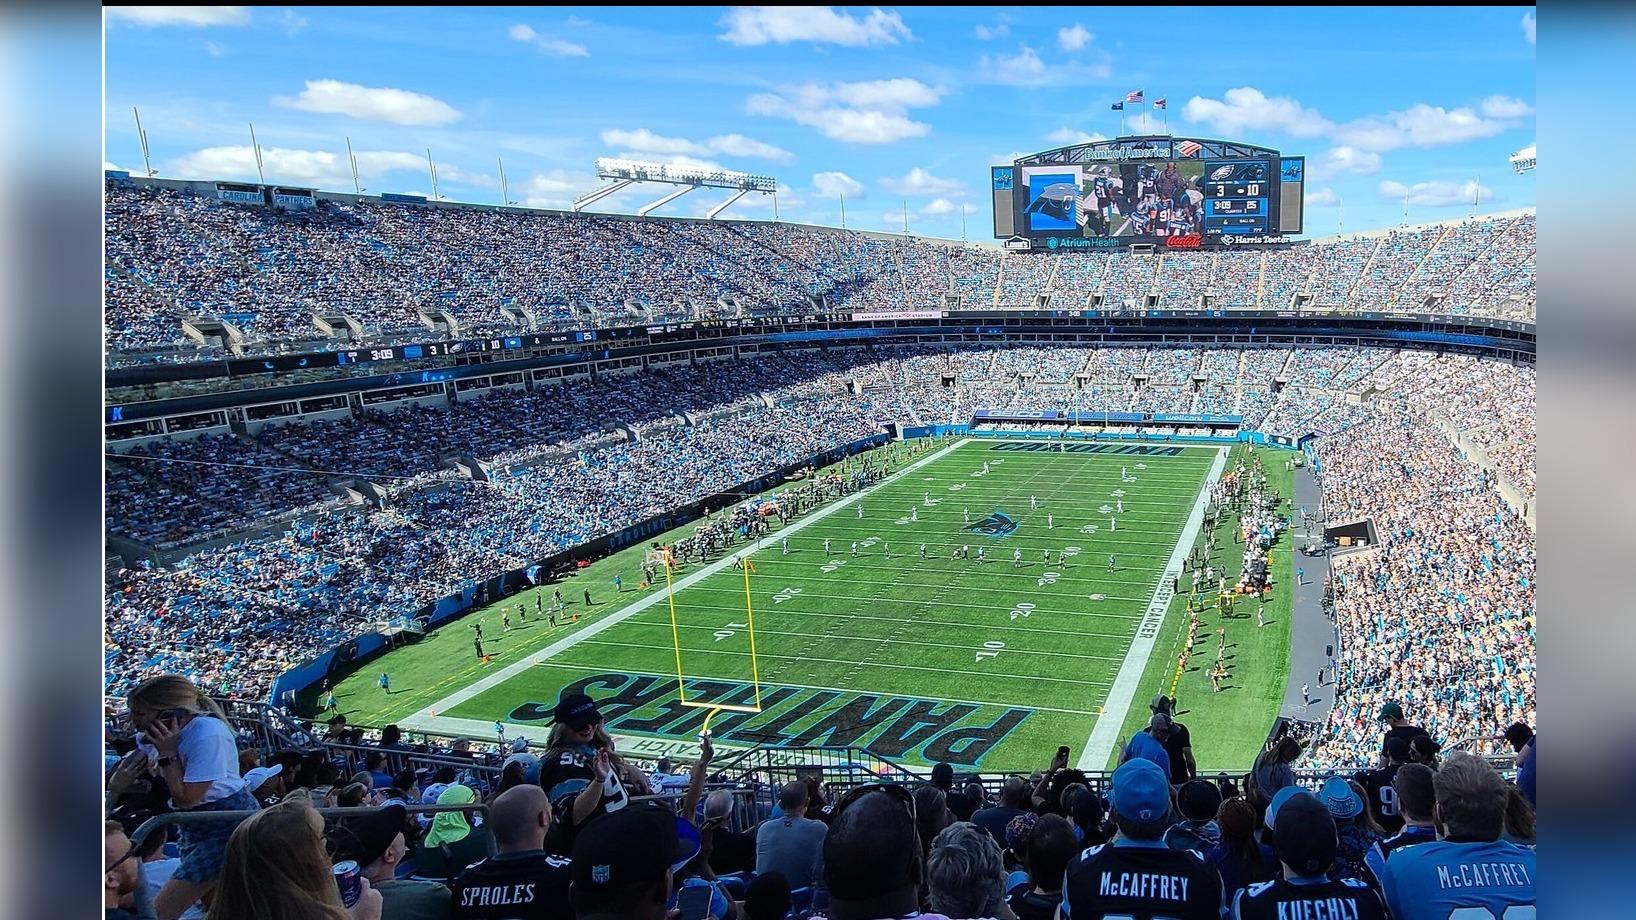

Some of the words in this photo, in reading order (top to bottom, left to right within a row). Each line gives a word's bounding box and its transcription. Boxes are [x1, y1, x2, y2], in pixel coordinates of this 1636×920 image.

[1084, 147, 1109, 159] Bank
[1109, 147, 1124, 160] of
[1125, 146, 1171, 159] America
[222, 190, 264, 203] CAROLINA
[275, 195, 313, 205] PANTHERS
[1217, 185, 1225, 197] 3
[1247, 184, 1259, 196] 10
[1214, 200, 1232, 210] 3:09
[1246, 200, 1257, 209] 25
[1160, 210, 1171, 222] 91
[1060, 239, 1091, 248] Atrium
[1091, 237, 1120, 248] Health
[1235, 236, 1262, 244] Harris
[1262, 235, 1290, 244] Teeter
[371, 349, 394, 360] 3:09
[430, 345, 437, 355] 3
[491, 339, 500, 350] 10
[988, 409, 1045, 418] GEICO
[987, 441, 1186, 457] CAROLINA
[1153, 570, 1180, 605] INTERCEPT
[1010, 602, 1036, 620] 20
[713, 621, 748, 638] 10
[1138, 607, 1164, 639] CANCER
[976, 640, 1006, 660] 10
[509, 671, 1034, 768] PANTHERS
[631, 739, 700, 757] CATCH
[1436, 863, 1531, 889] McCAFFREY
[461, 883, 535, 907] SPROLES
[1099, 871, 1189, 902] McCAFFREY
[1277, 897, 1360, 920] KUECHLY
